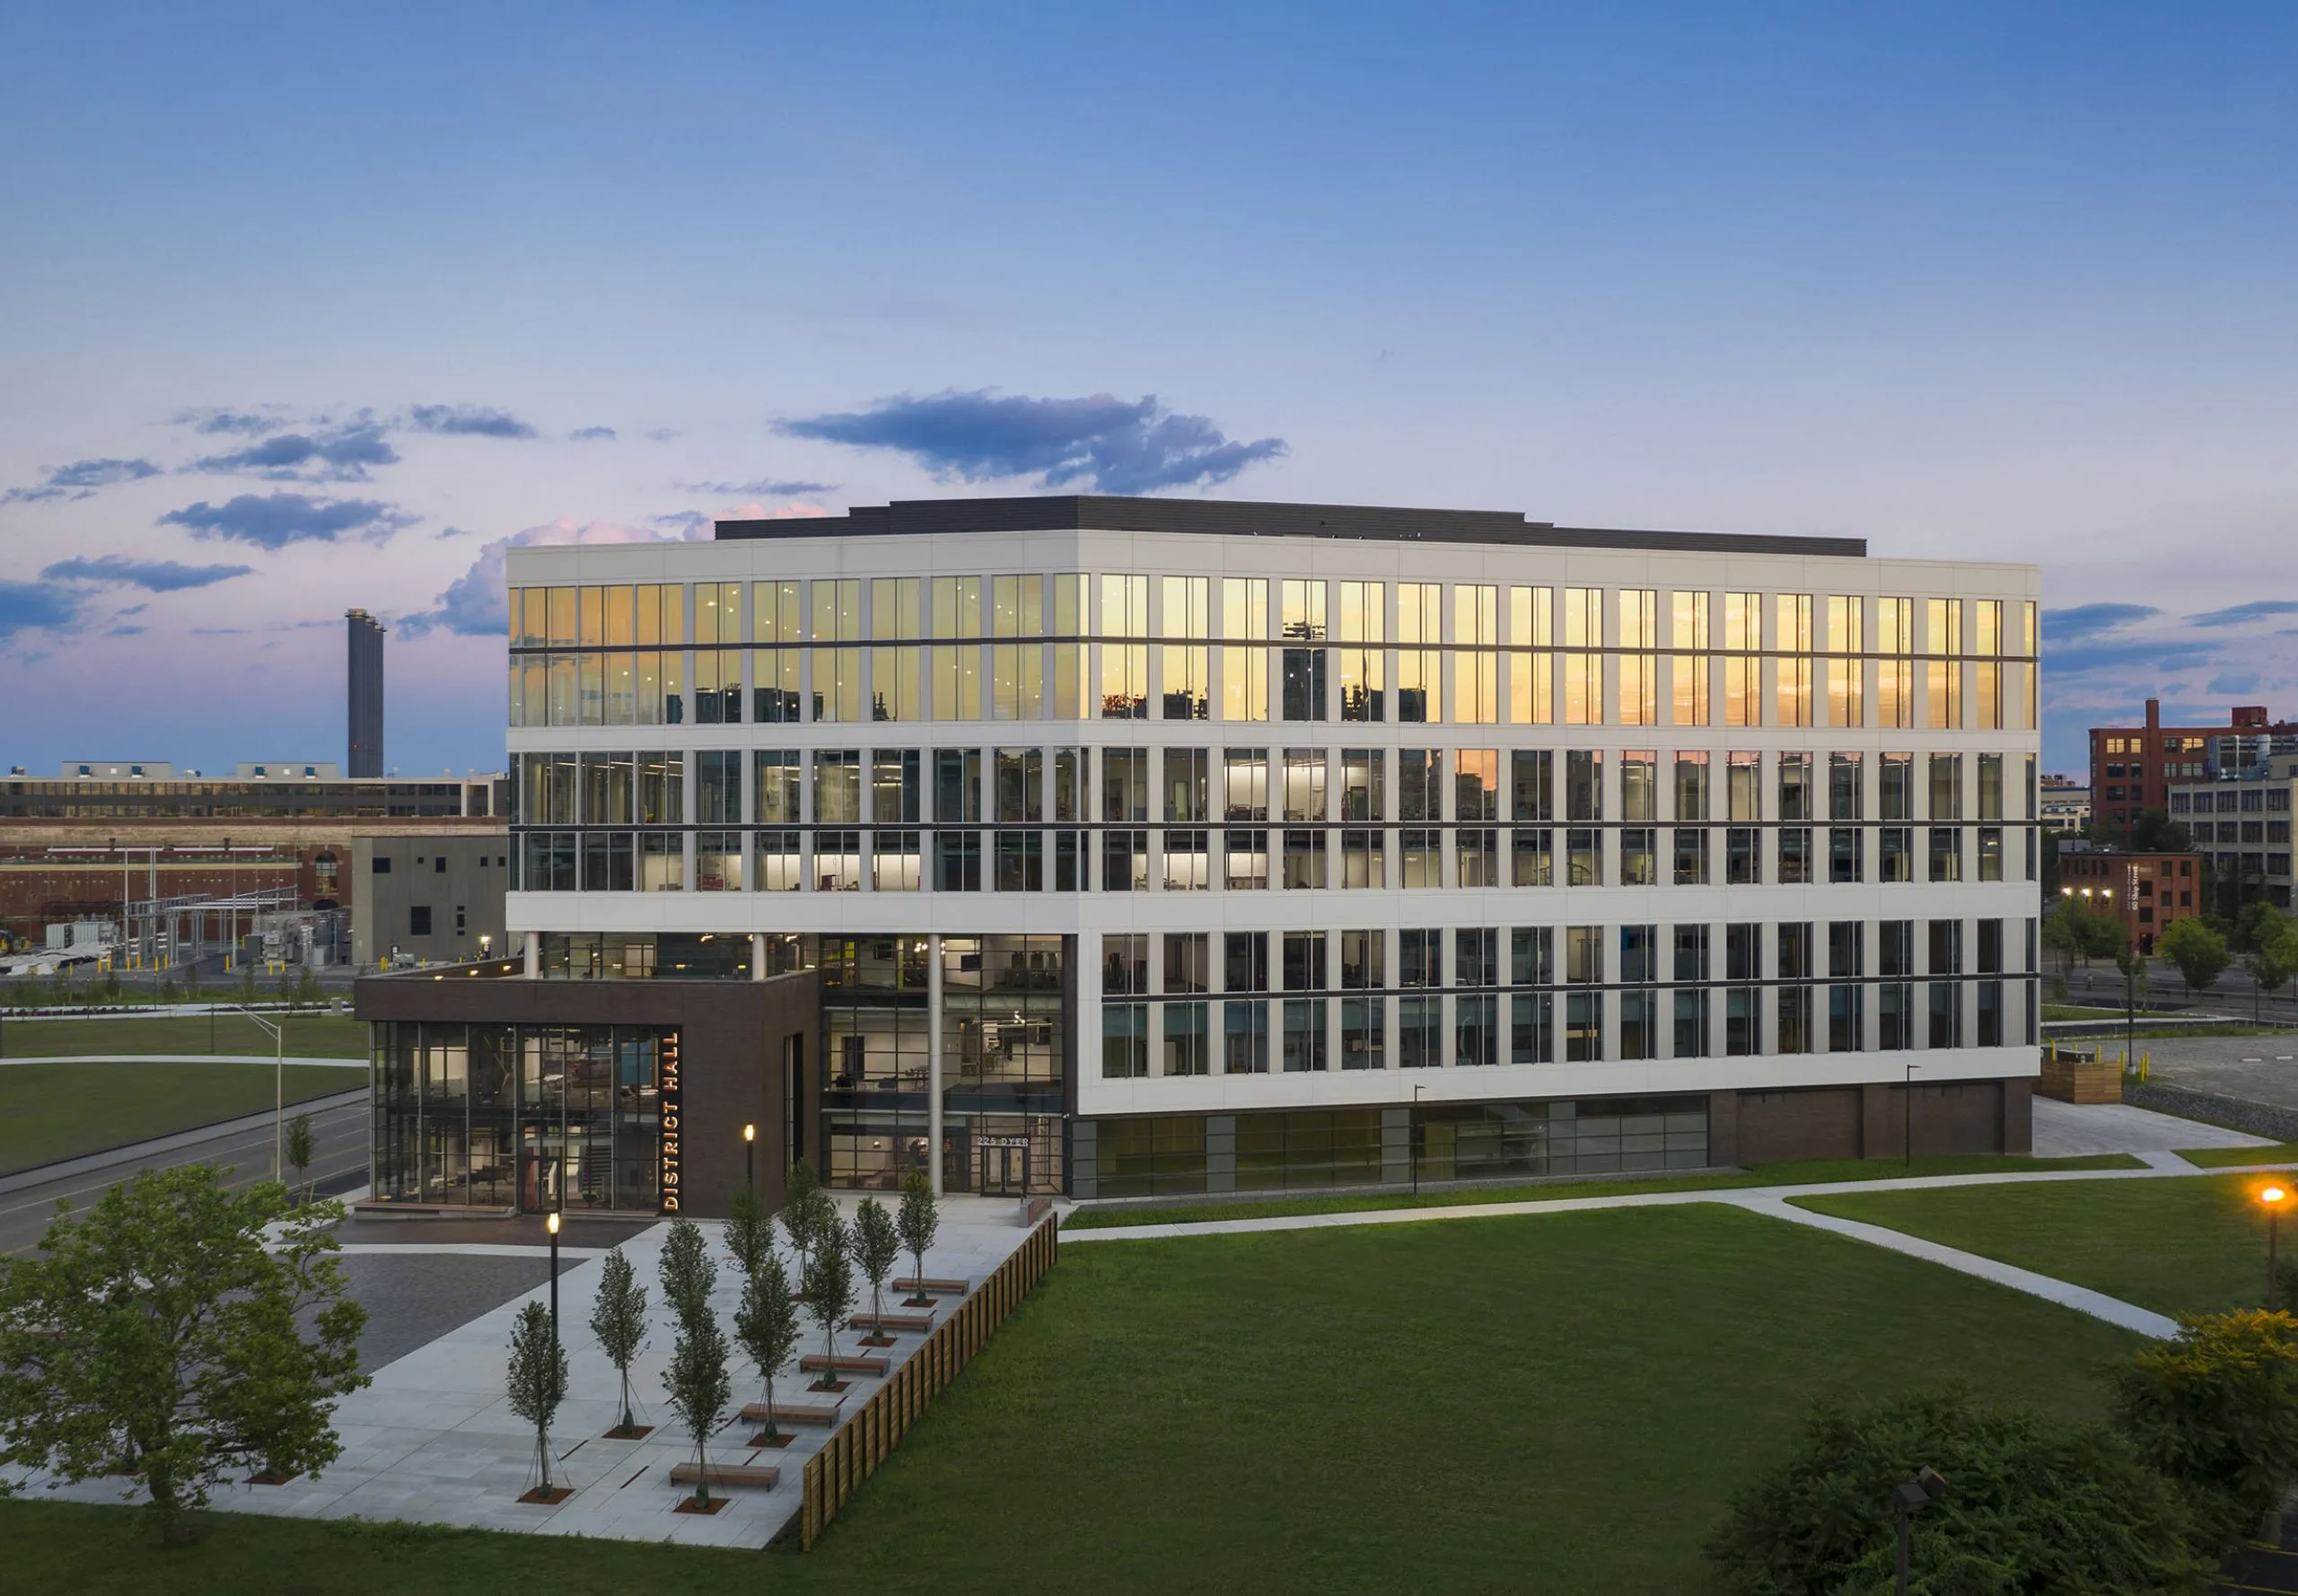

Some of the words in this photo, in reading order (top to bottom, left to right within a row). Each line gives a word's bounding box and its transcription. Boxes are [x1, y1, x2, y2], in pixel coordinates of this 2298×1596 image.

[2132, 901, 2138, 910] 60
[662, 1032, 678, 1091] HALL
[663, 1101, 679, 1210] DISTRICT
[978, 1136, 996, 1145] 225
[1001, 1137, 1029, 1146] DYER
